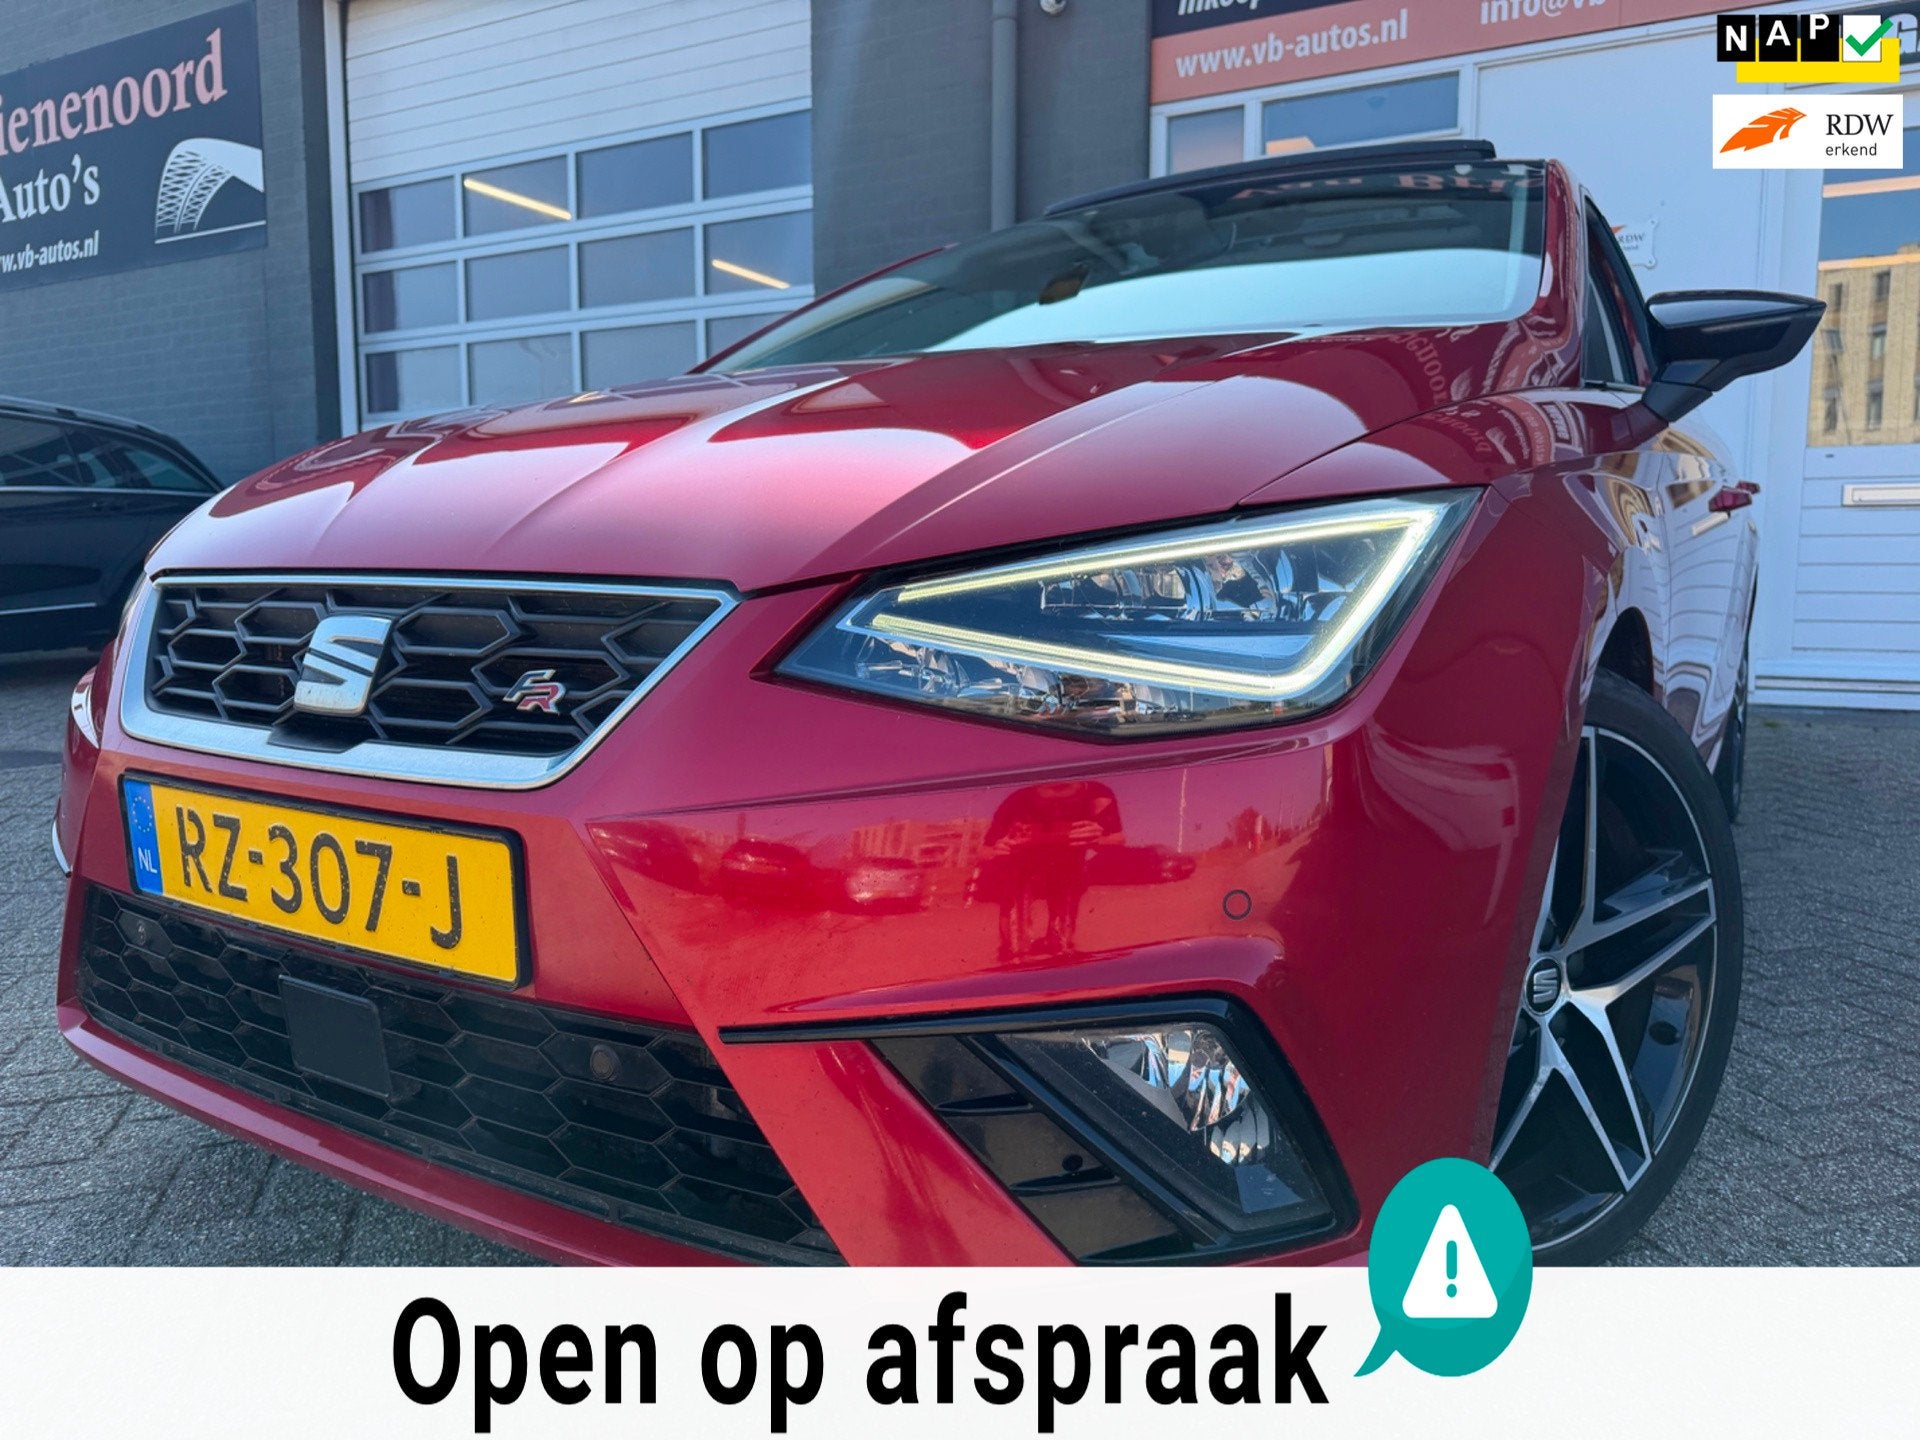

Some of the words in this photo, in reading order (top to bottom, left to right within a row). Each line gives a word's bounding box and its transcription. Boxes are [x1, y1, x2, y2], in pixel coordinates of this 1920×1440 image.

[1175, 8, 1409, 78] www.vb-autos.nl
[0, 230, 100, 273] w.vb-autos.nl
[137, 845, 158, 875] NL
[175, 803, 463, 950] RZ-307-J
